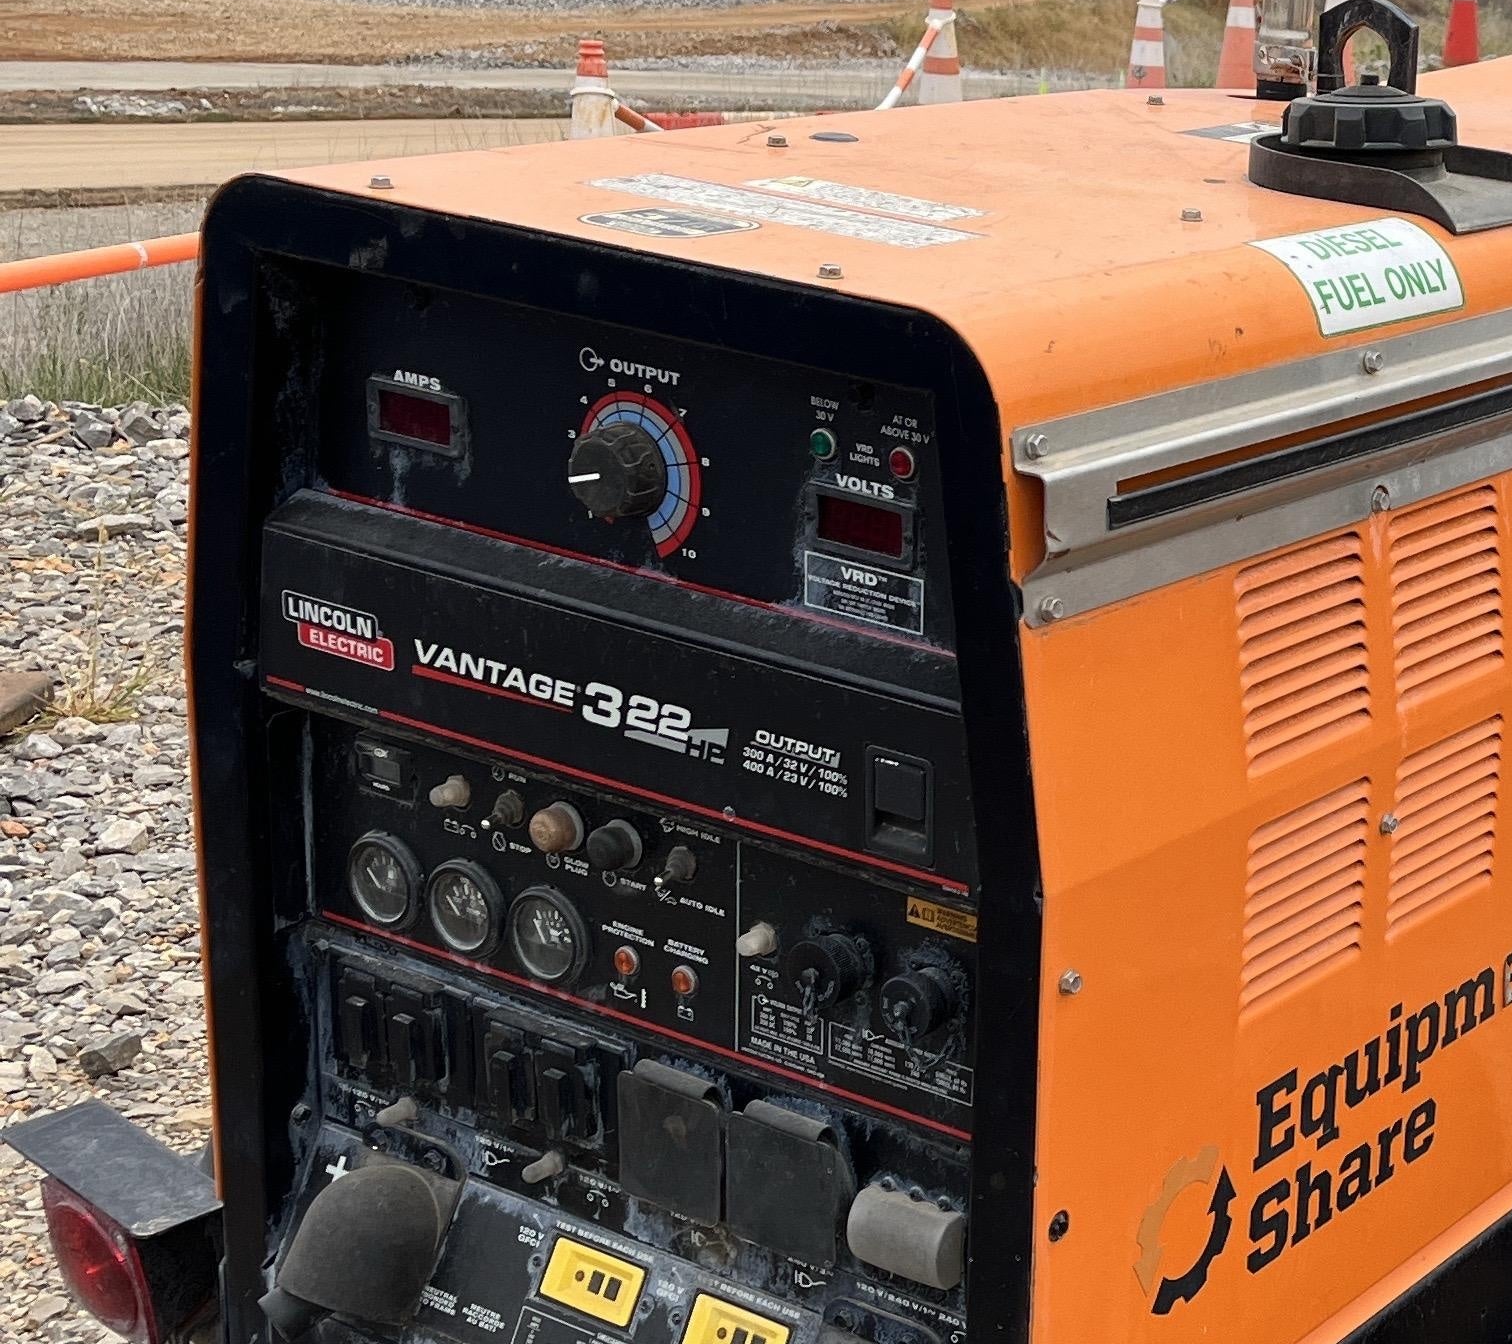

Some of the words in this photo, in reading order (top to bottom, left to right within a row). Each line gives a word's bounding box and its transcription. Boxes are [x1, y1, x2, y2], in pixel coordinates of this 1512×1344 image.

[1298, 228, 1401, 261] DIESEL
[1312, 272, 1384, 315] FUEL
[1386, 260, 1449, 303] ONLY
[393, 369, 442, 392] AMPS
[610, 358, 681, 386] OUTPUT
[579, 395, 589, 406] 4
[810, 395, 840, 411] BELOW
[815, 409, 827, 422] 30
[826, 412, 836, 423] V
[567, 429, 577, 440] 3
[910, 431, 922, 443] 30
[849, 451, 880, 468] LIGHTS
[834, 472, 895, 500] VOLTS
[287, 596, 373, 639] LINCOLN
[309, 628, 385, 663] ELECTRIC
[413, 638, 578, 708] VANTAGE
[582, 681, 693, 740] 322
[754, 728, 836, 763] OUTPUT
[742, 746, 764, 761] 300
[764, 751, 776, 764] A
[782, 757, 798, 770] 32
[797, 762, 809, 774] V
[817, 768, 849, 787] 100%
[742, 759, 764, 775] 400
[765, 765, 776, 778] A
[798, 775, 810, 787] V
[817, 781, 849, 799] 100%
[508, 841, 533, 854] STOP
[619, 877, 648, 892] START
[679, 896, 704, 911] AUTO
[703, 904, 726, 918] IDLE
[601, 923, 656, 948] PROTECTION
[1246, 1097, 1437, 1274] Share
[518, 1225, 537, 1238] 120
[555, 1220, 577, 1234] TEST
[577, 1227, 611, 1247] BEFORE
[611, 1240, 637, 1257] EACH
[720, 1283, 756, 1303] BEFORE
[756, 1297, 781, 1312] EACH
